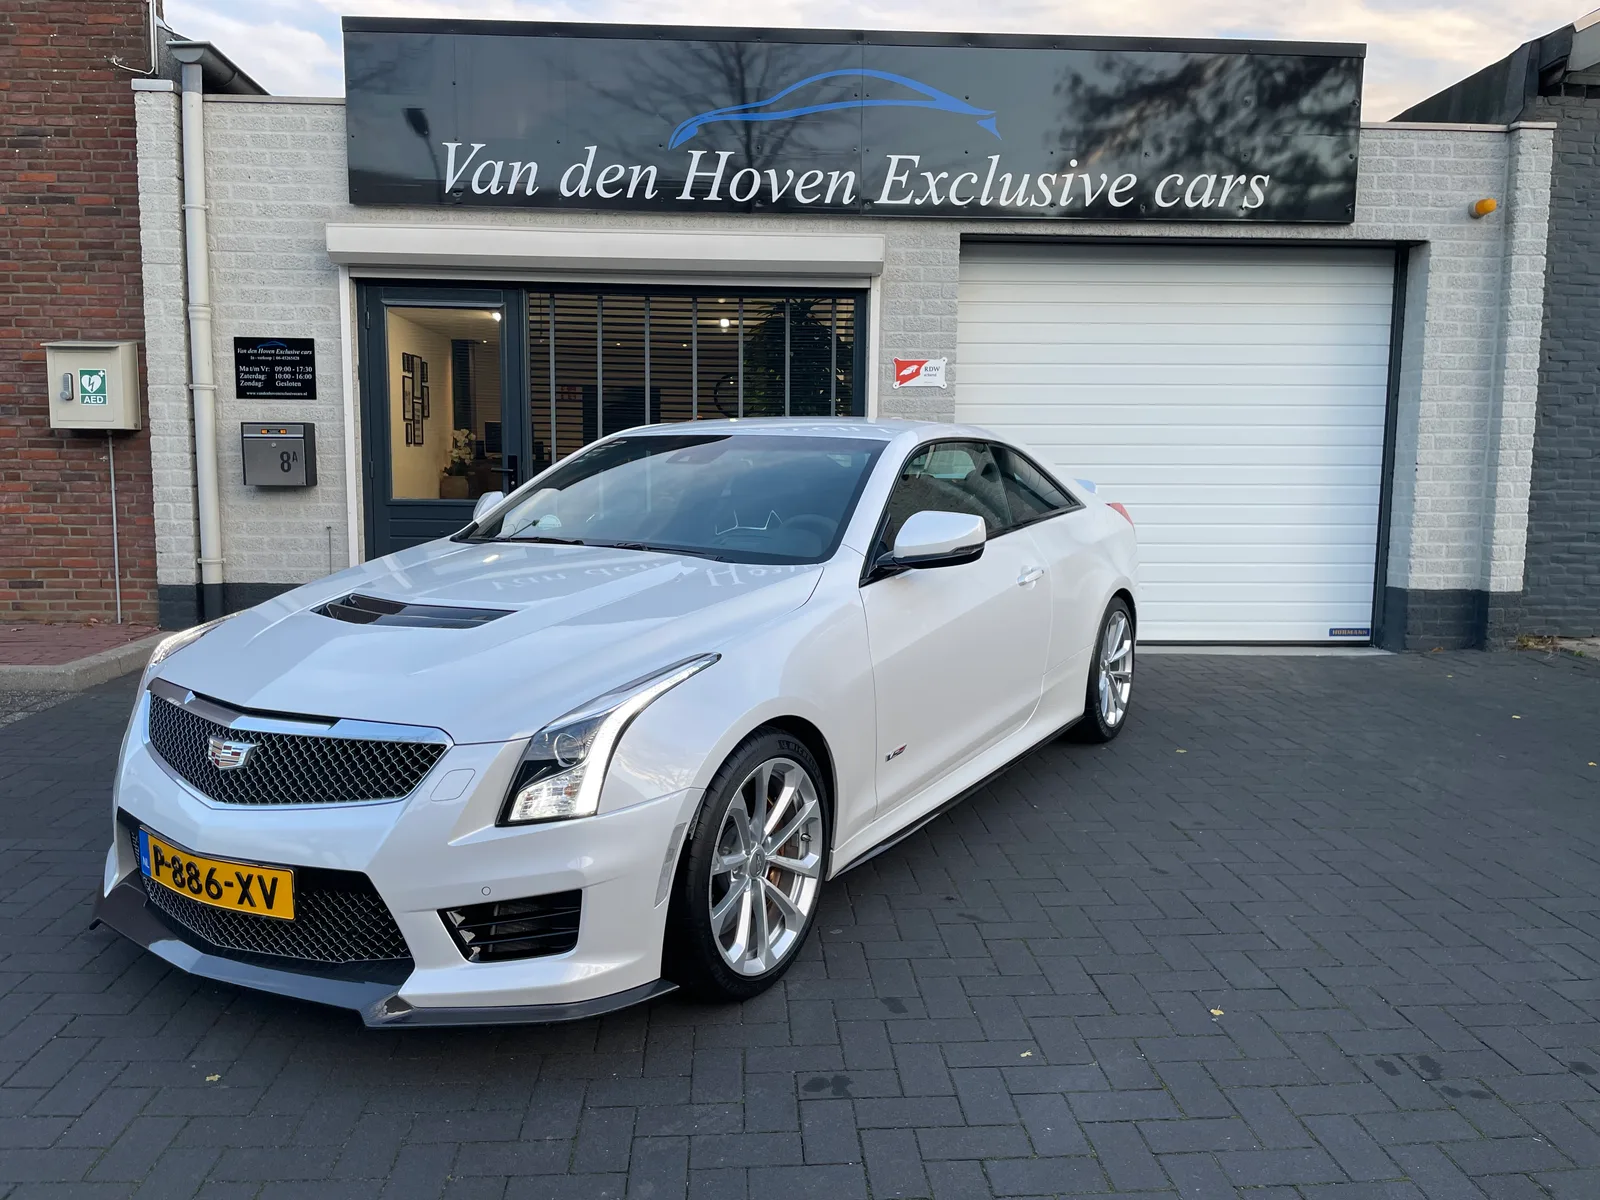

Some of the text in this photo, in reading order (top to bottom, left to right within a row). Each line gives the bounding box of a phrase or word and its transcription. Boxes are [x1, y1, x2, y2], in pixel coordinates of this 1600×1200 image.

[442, 142, 1271, 210] Van den Hoven Exclusive cars
[83, 396, 104, 404] AED
[142, 857, 150, 869] NL
[152, 844, 279, 909] P-886-XV
